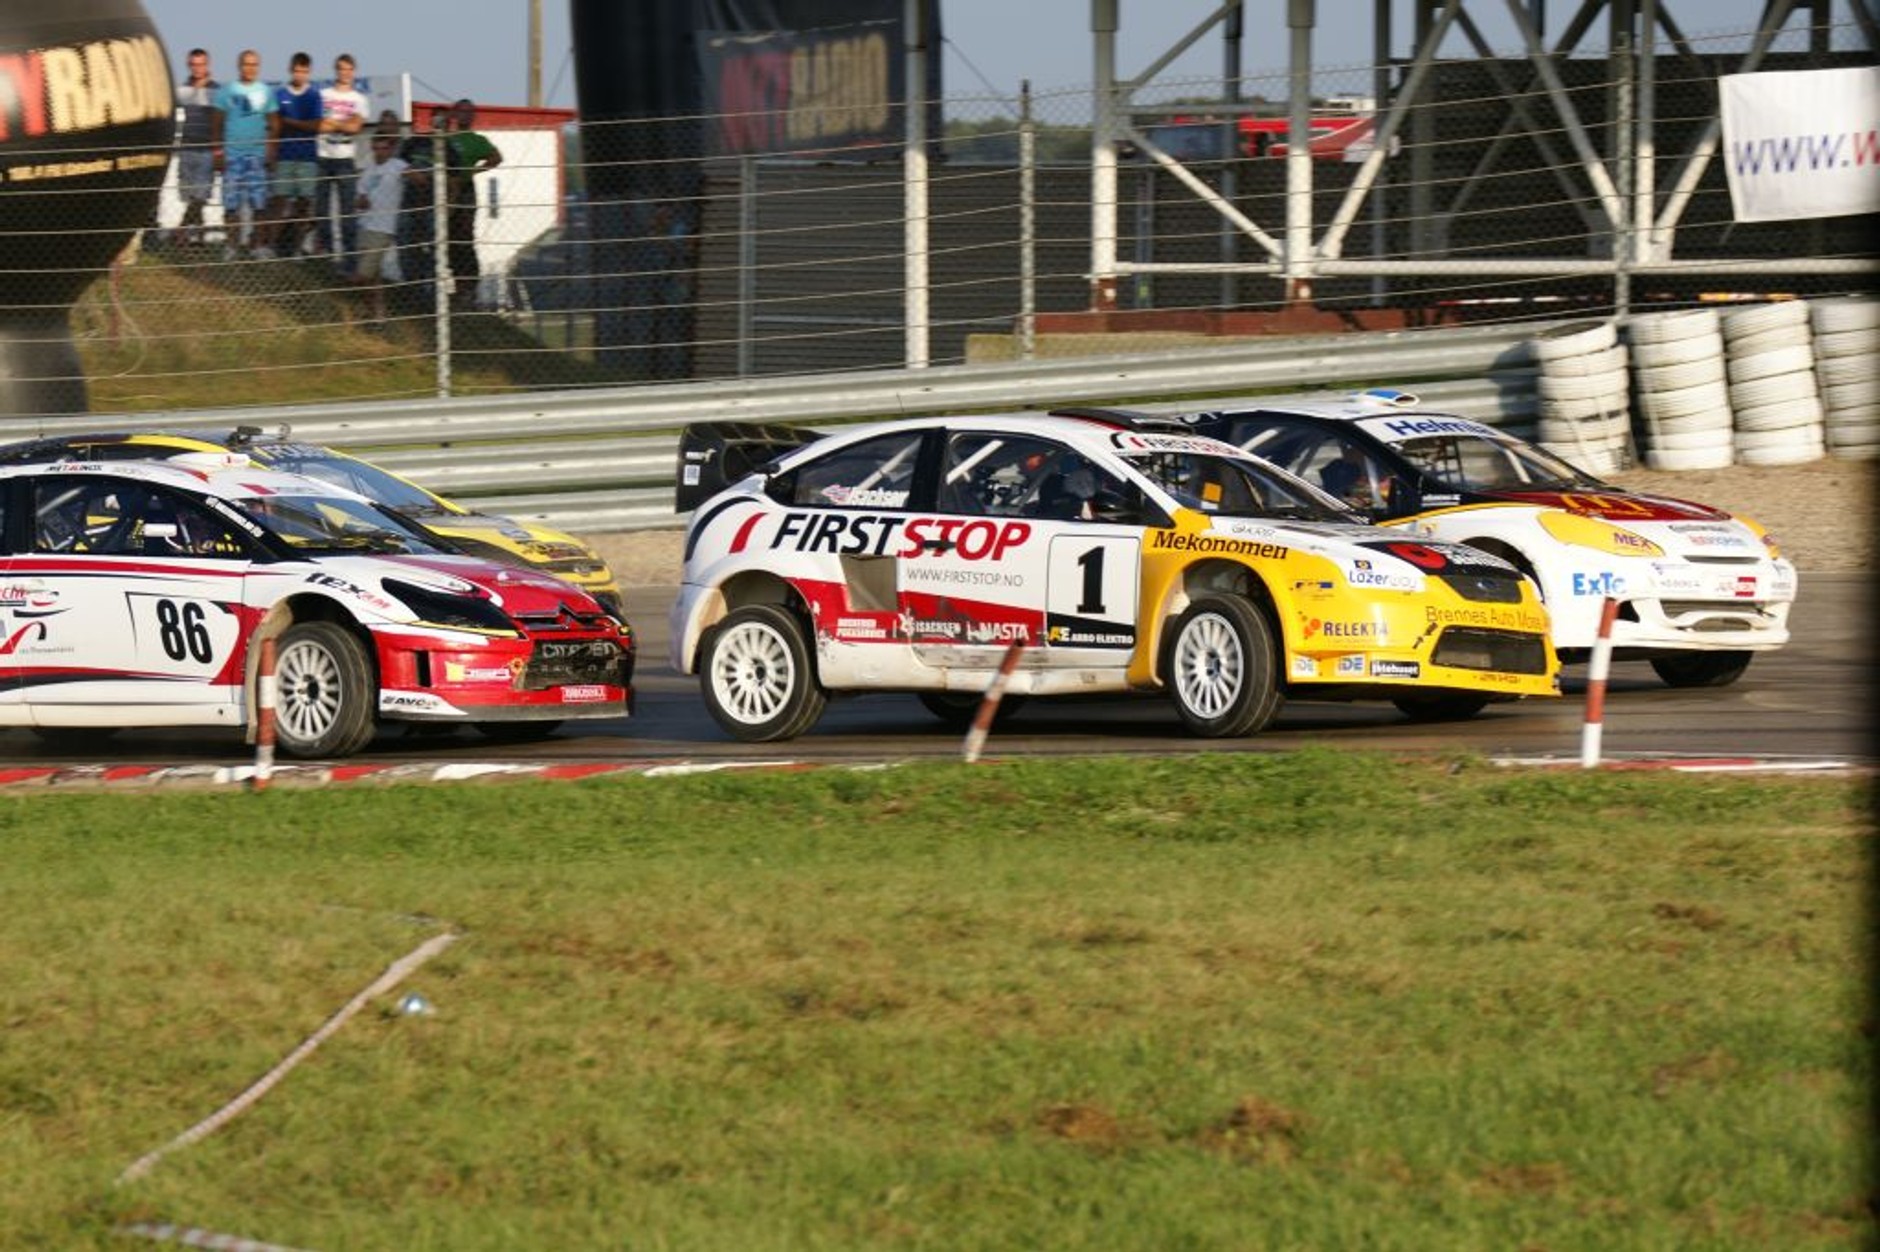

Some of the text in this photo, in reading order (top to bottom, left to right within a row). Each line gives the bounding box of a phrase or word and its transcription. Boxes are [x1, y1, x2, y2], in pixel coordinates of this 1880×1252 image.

[1153, 530, 1289, 560] Mekonomen
[907, 567, 1024, 588] WWW.FIRSTSTOP.NO
[1077, 546, 1106, 614] 1
[1425, 606, 1488, 624] Brennes
[156, 598, 213, 664] 86
[1323, 621, 1389, 637] RELEKTA
